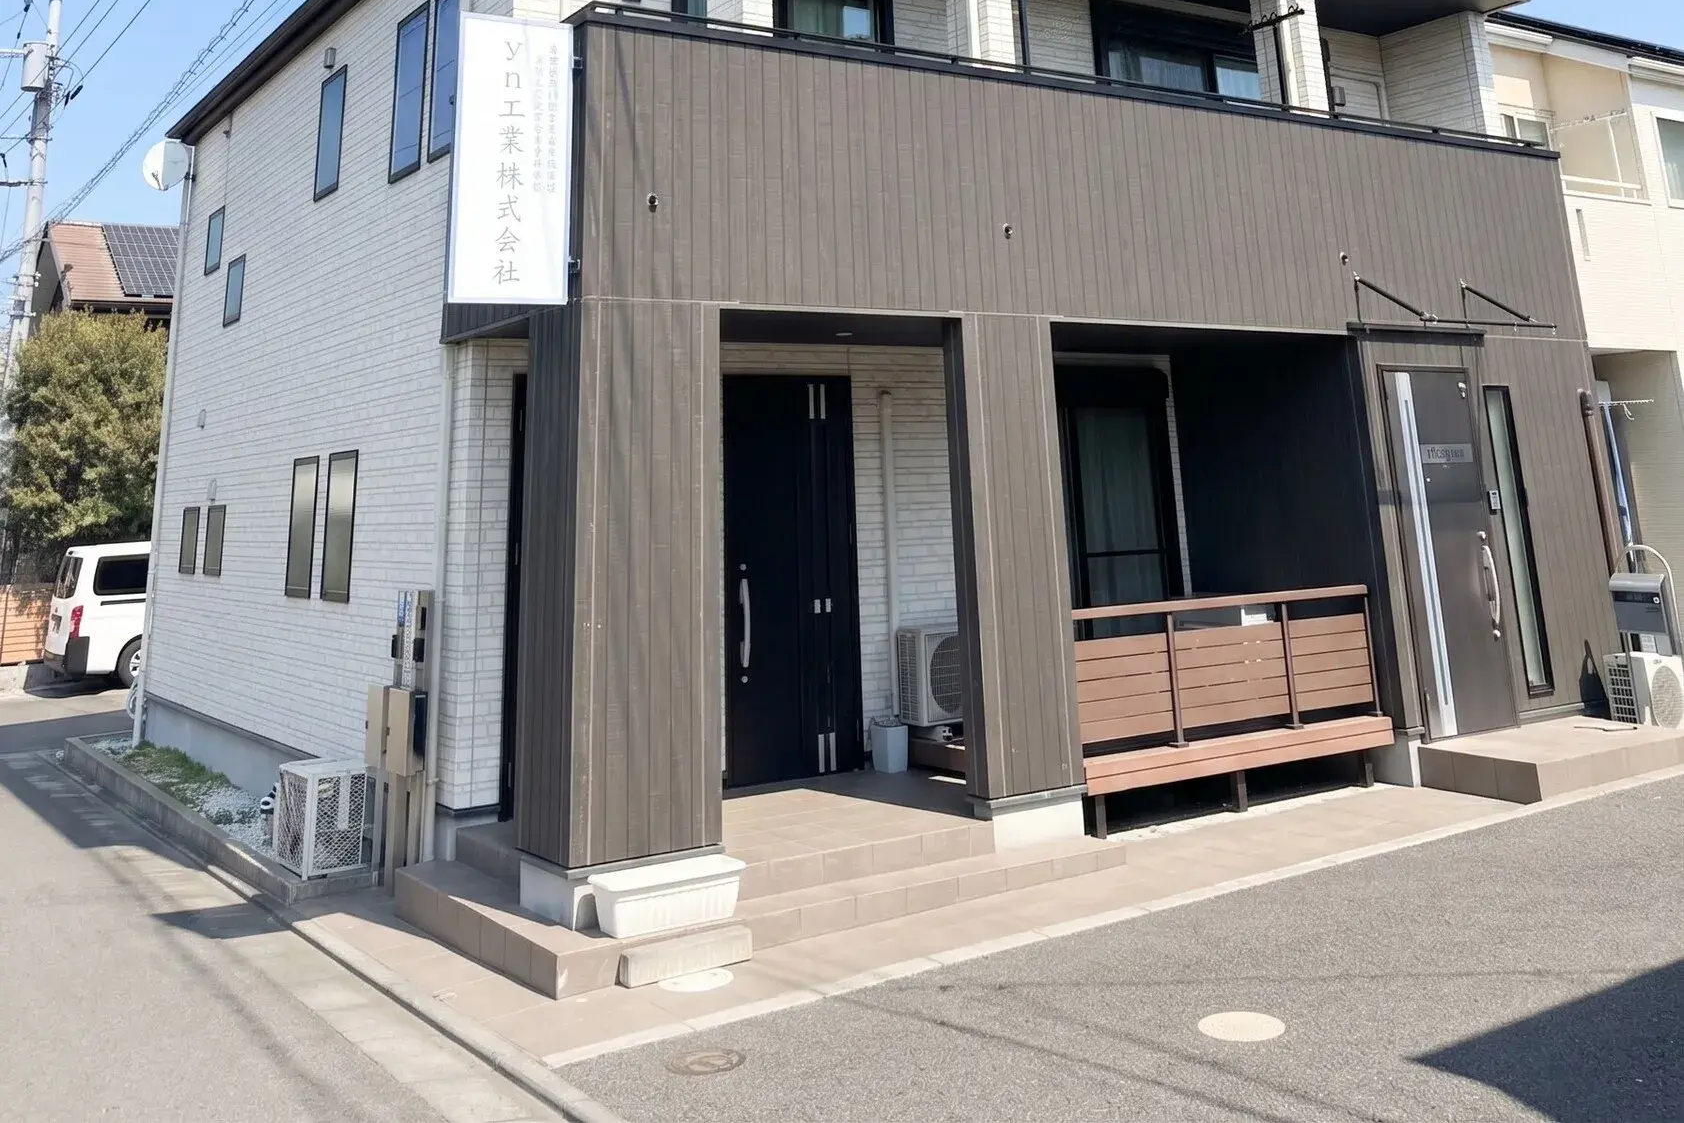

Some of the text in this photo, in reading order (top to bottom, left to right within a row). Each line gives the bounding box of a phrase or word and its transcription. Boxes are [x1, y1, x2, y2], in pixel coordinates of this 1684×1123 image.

[493, 40, 526, 285] yn工業株式会社
